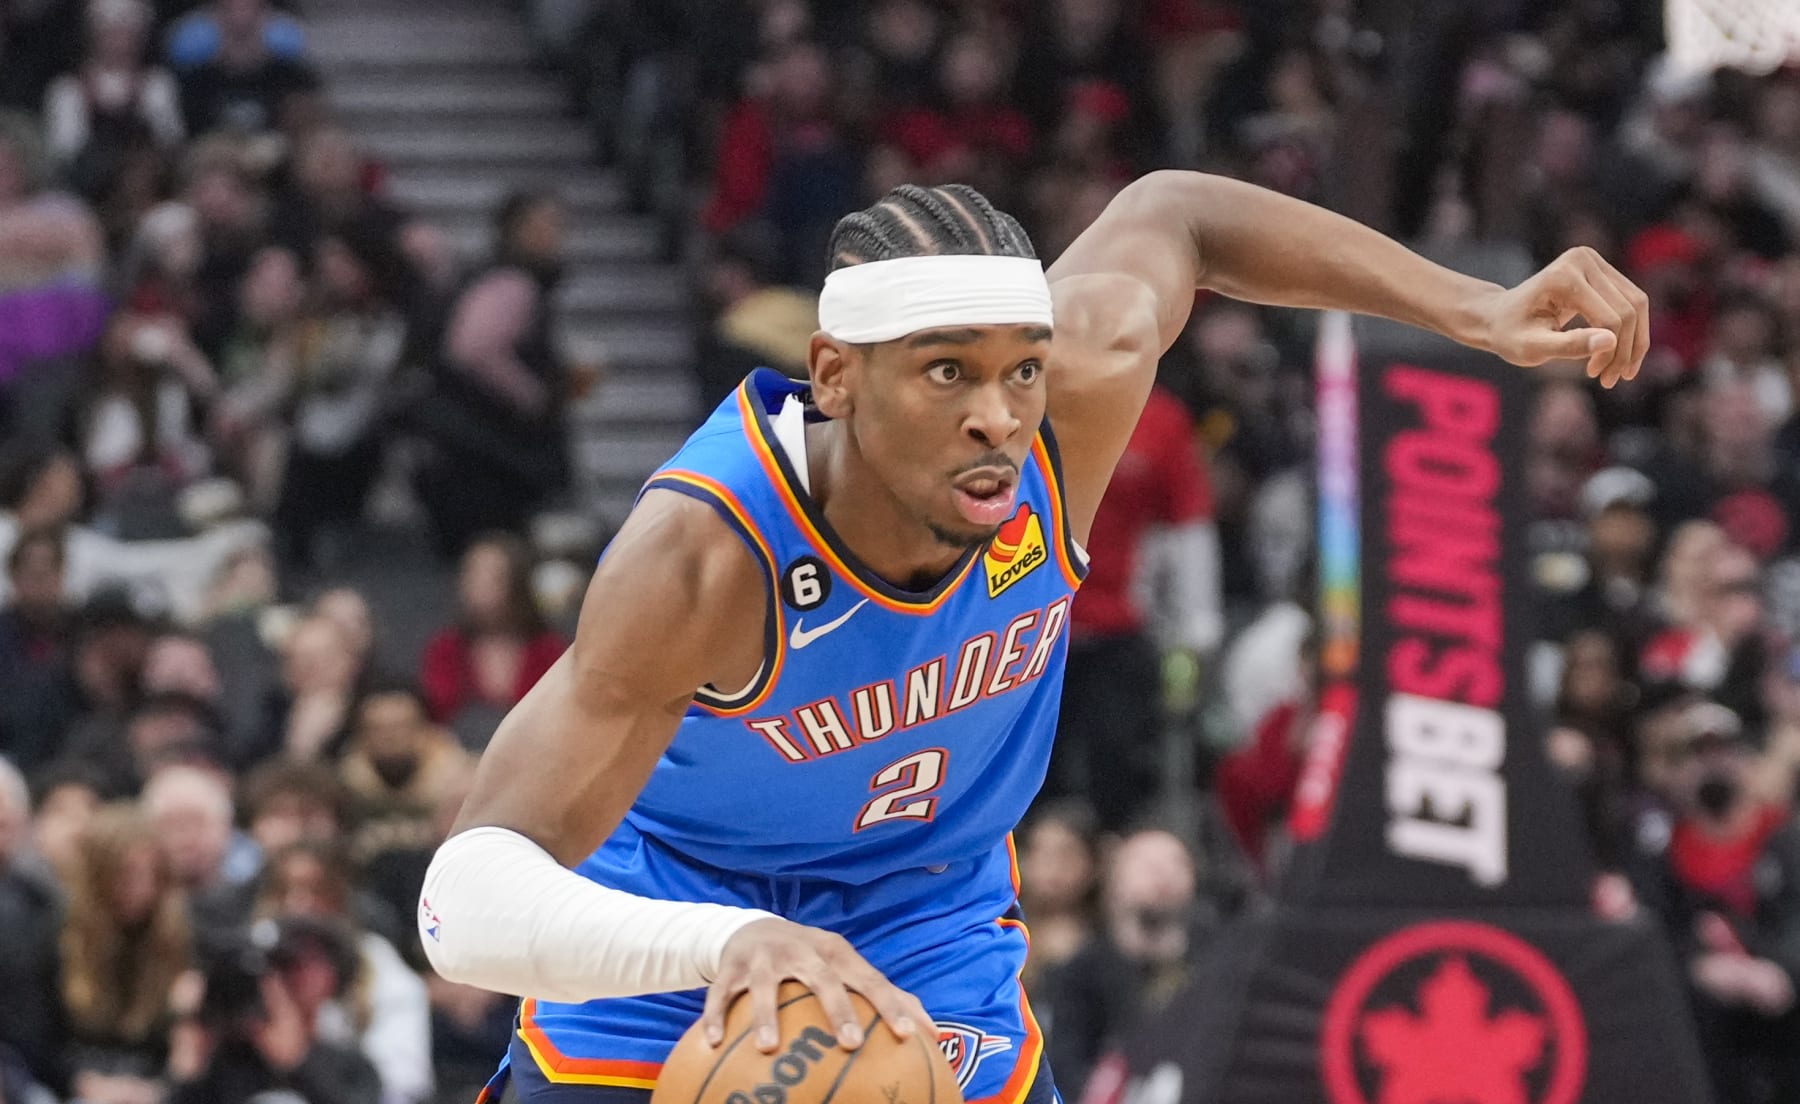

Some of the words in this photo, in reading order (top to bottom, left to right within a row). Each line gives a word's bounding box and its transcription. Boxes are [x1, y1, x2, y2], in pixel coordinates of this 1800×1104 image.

[791, 563, 822, 606] 6
[1385, 364, 1508, 888] POINTSBET
[743, 594, 1071, 763] THUNDER
[853, 747, 949, 833] 2
